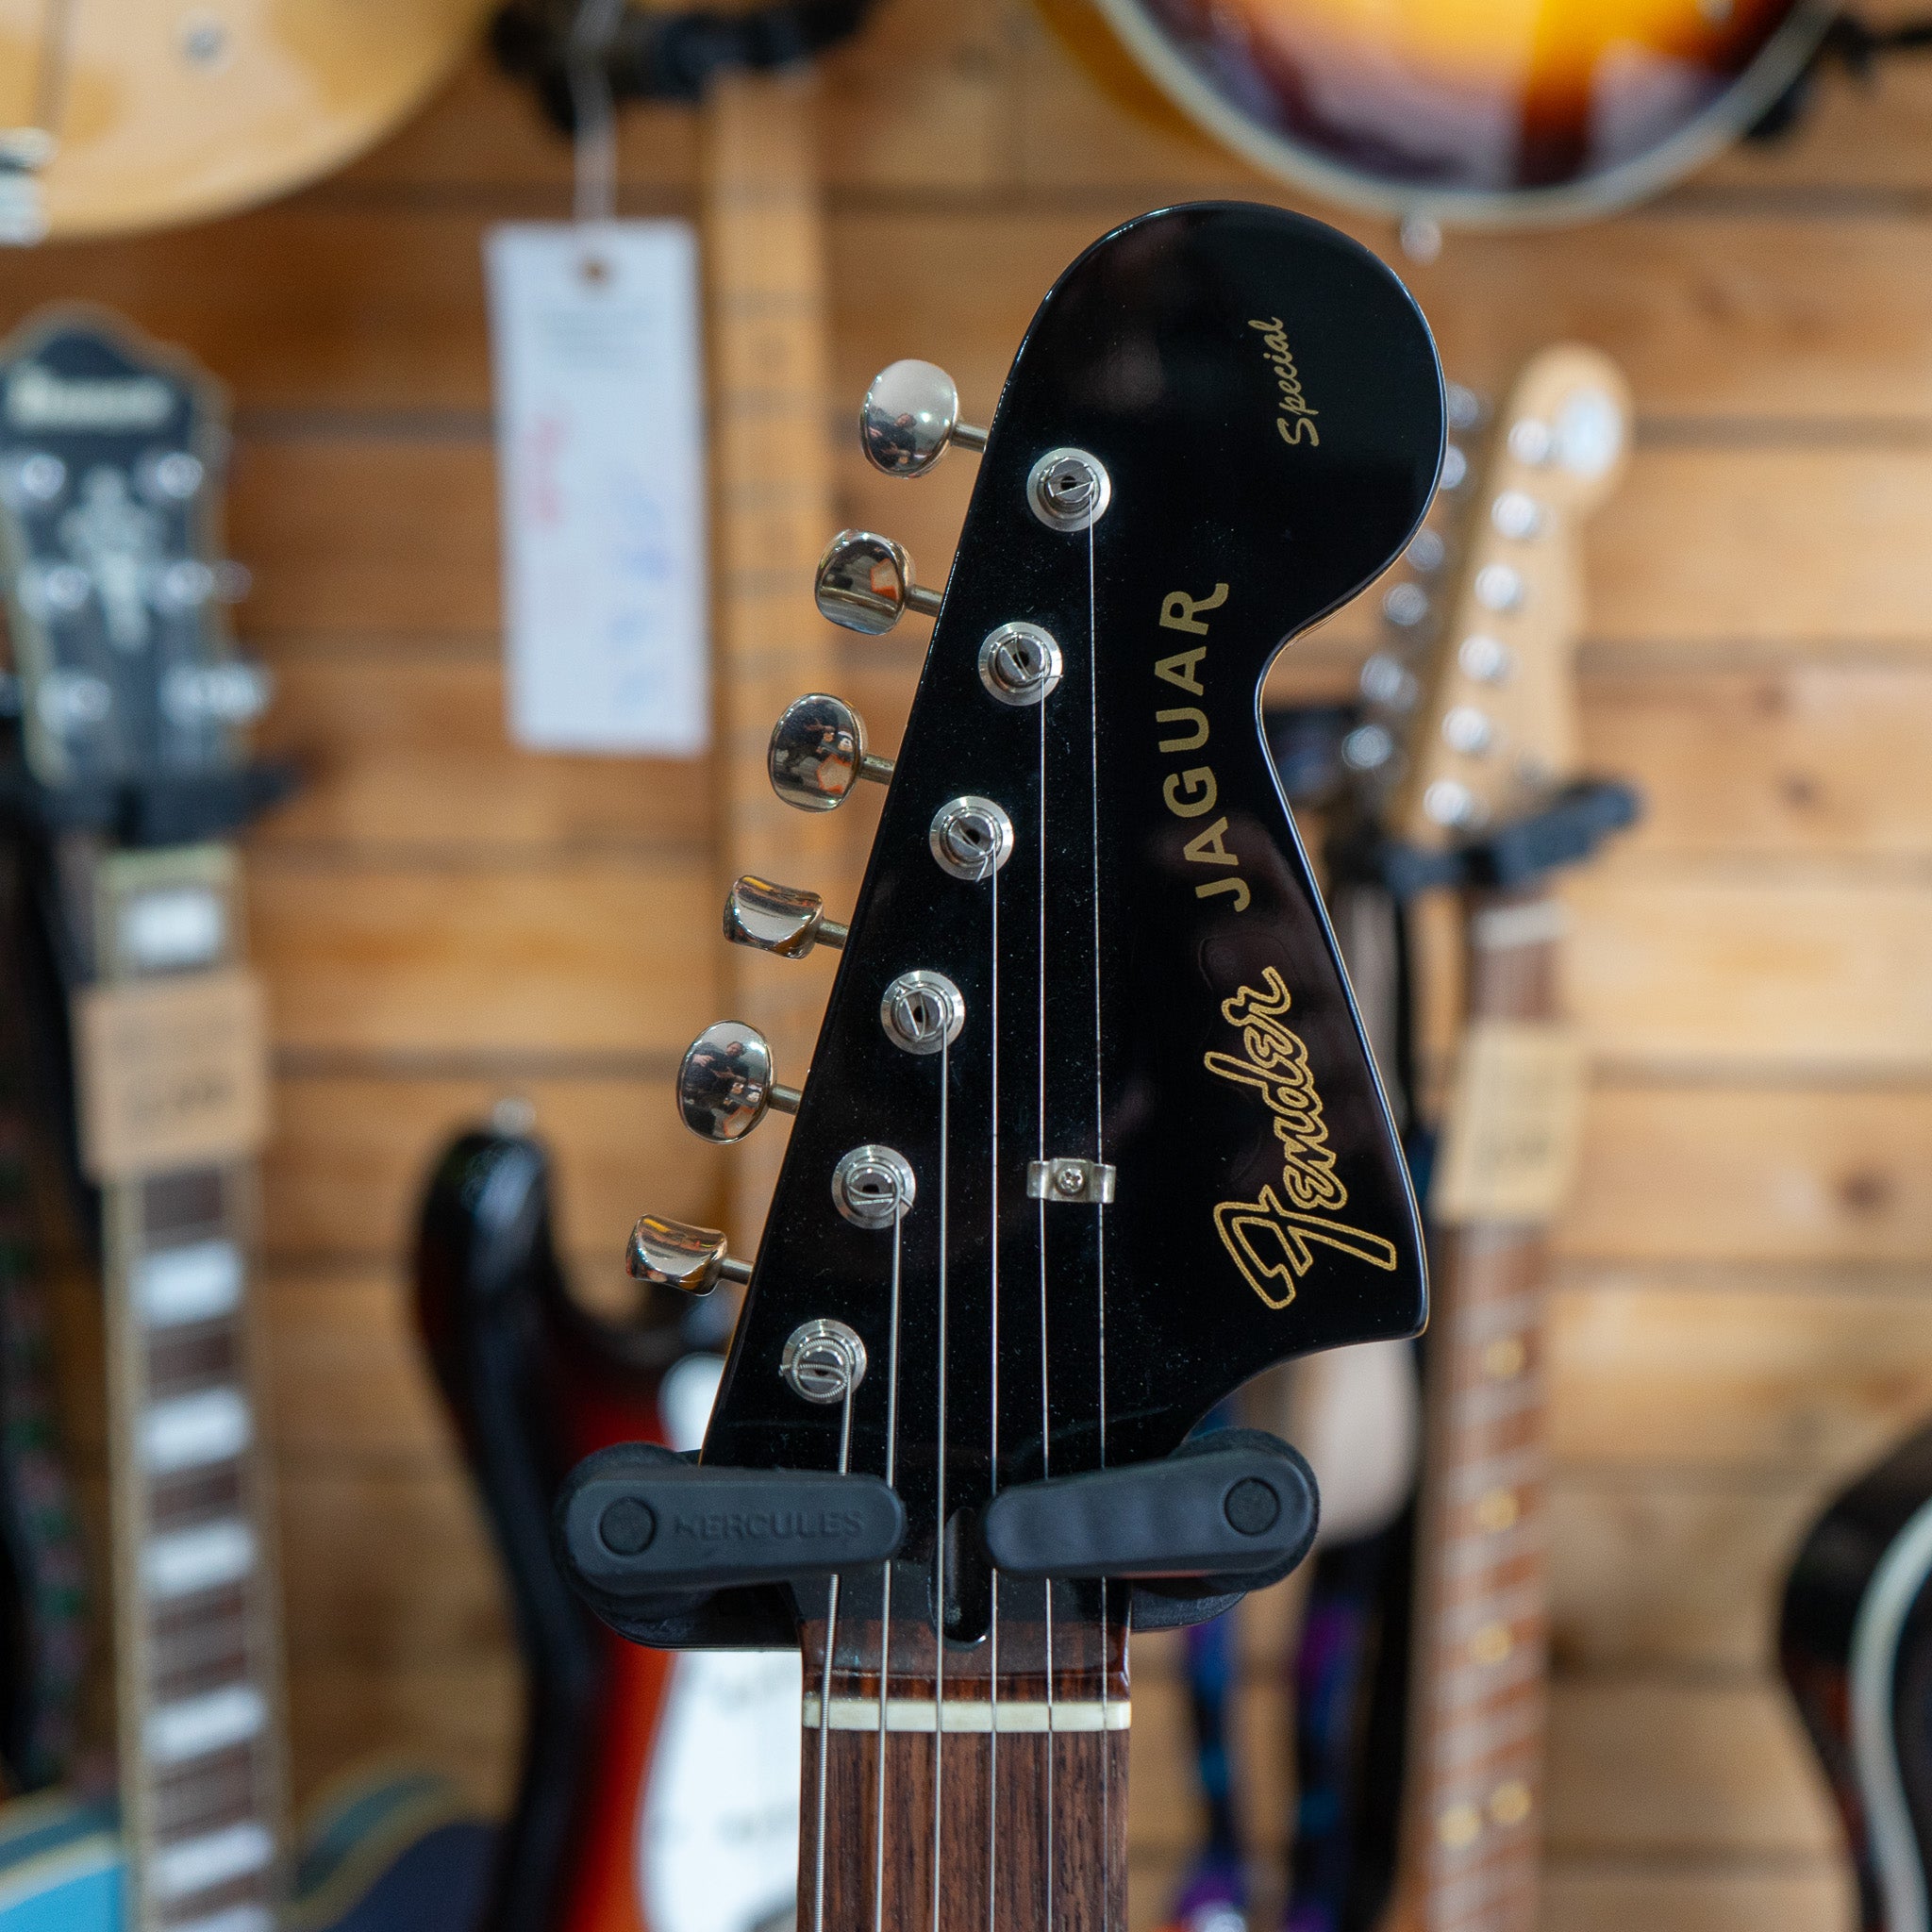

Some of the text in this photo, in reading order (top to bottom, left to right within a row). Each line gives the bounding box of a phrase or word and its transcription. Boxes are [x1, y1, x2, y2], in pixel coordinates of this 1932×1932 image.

[1248, 316, 1319, 447] Special
[1154, 582, 1251, 912] JAGUAR
[1204, 966, 1396, 1309] Fender
[673, 1510, 864, 1541] HERCULES
